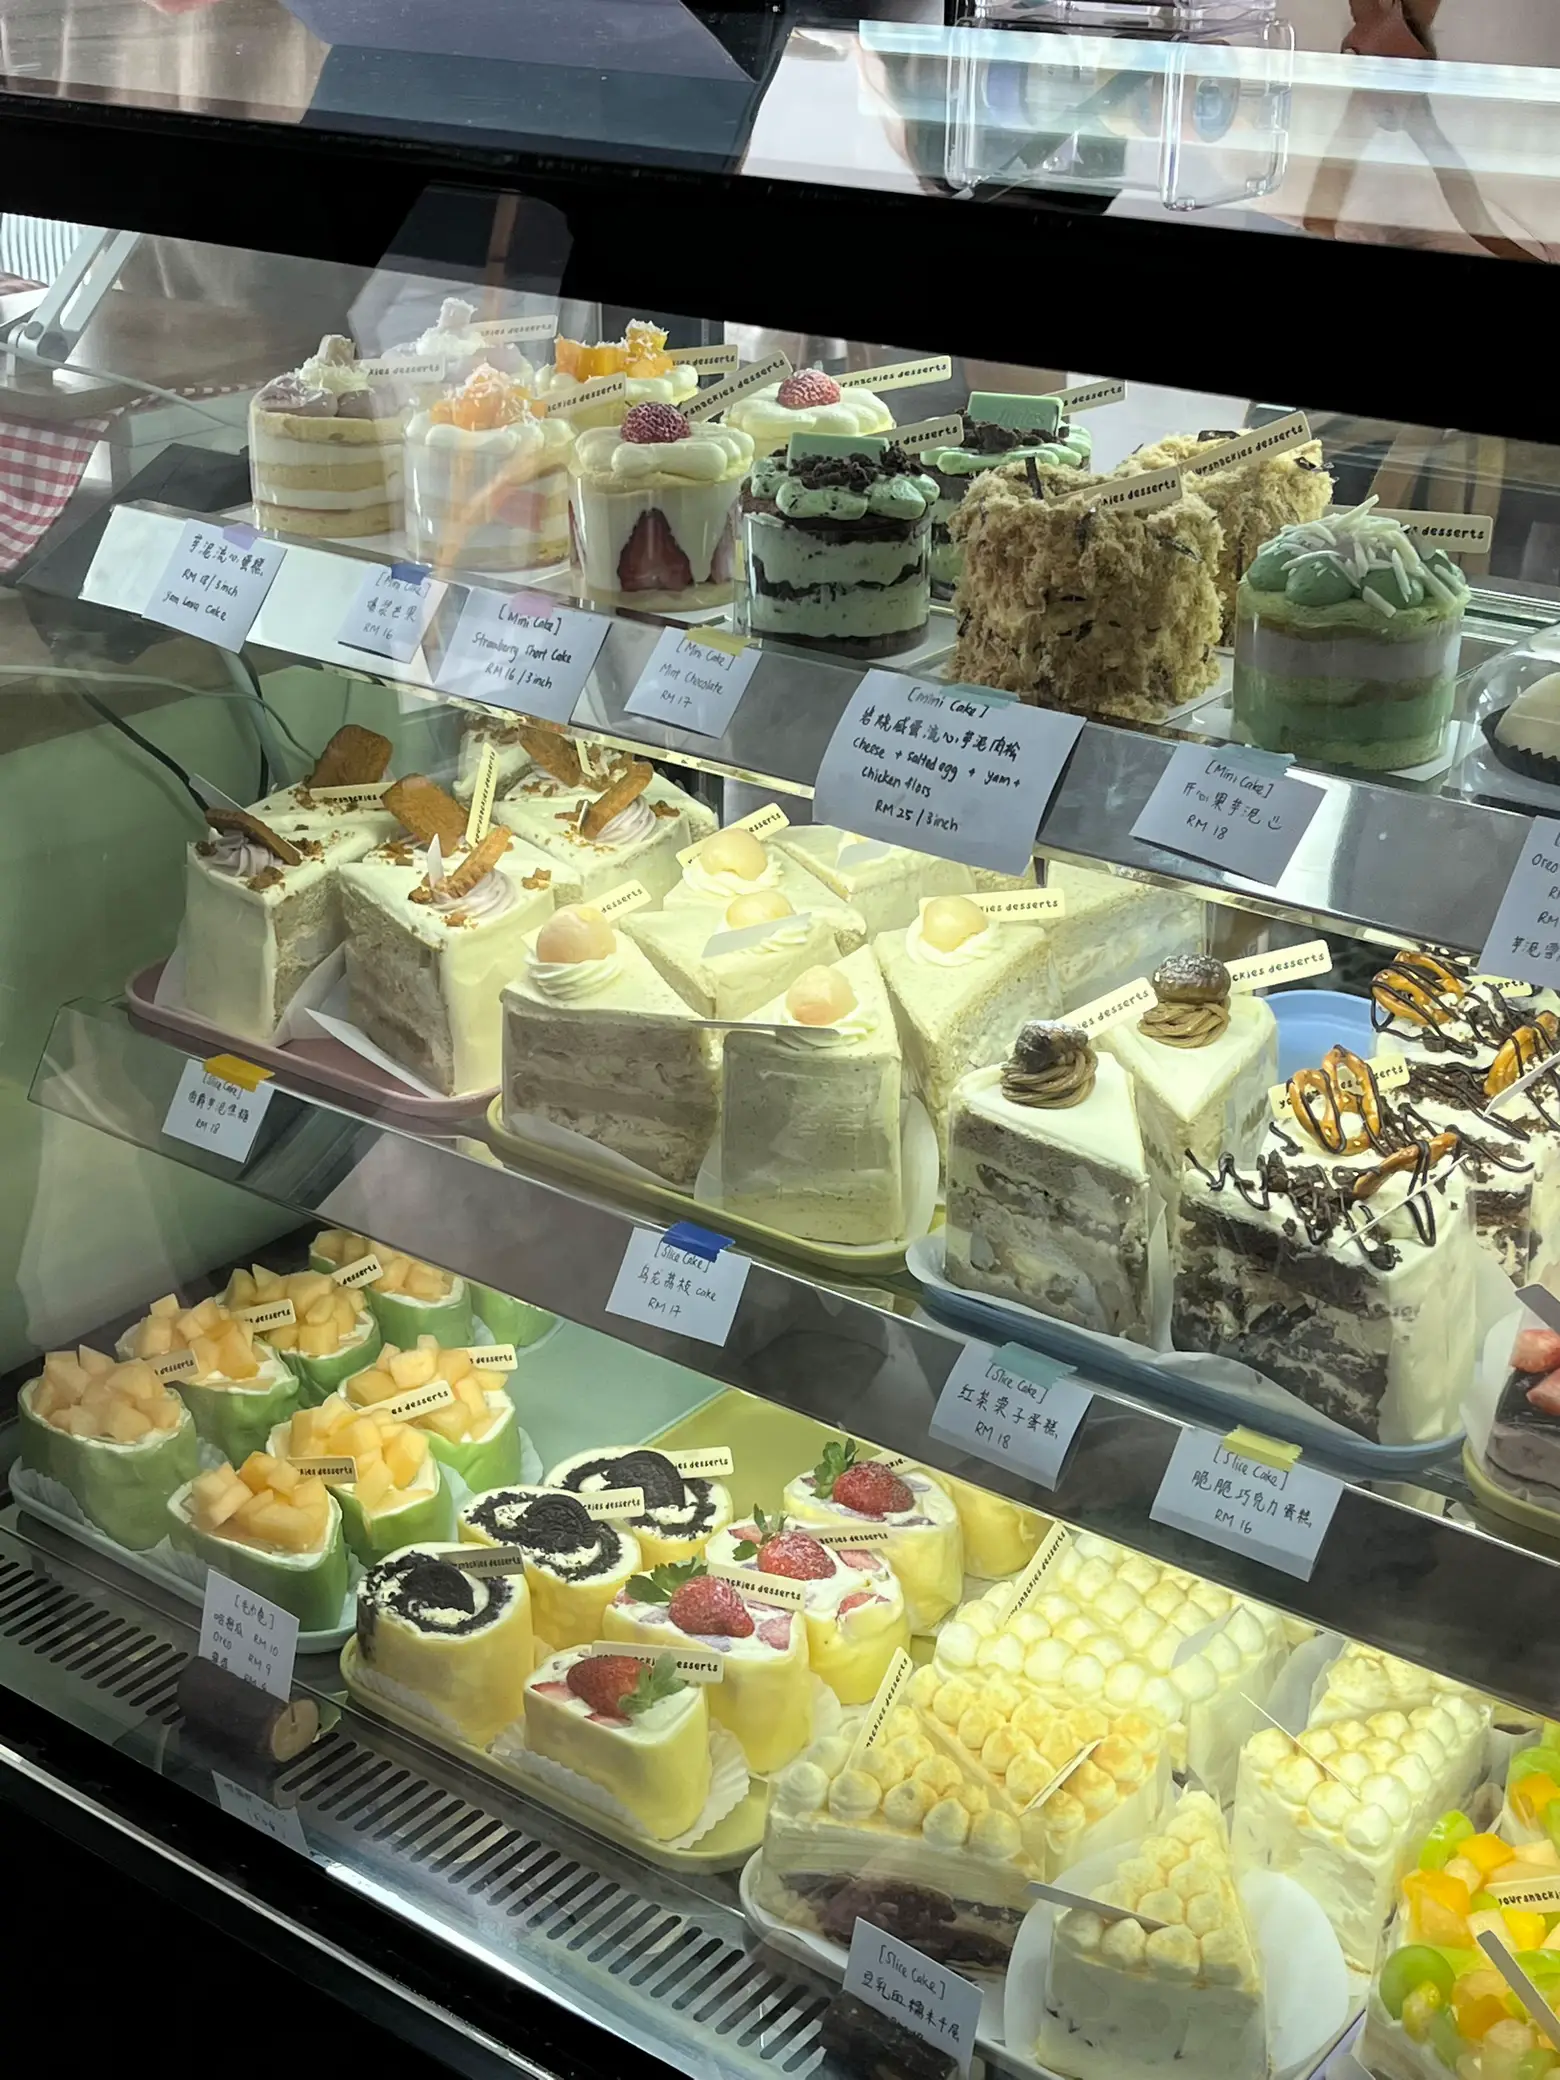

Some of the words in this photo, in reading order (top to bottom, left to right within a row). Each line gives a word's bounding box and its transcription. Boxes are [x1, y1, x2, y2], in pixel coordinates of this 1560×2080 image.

[692, 355, 736, 367] desserts
[897, 362, 947, 379] desserts
[737, 358, 785, 390] desserts
[578, 382, 623, 403] desserts
[1071, 385, 1123, 406] desserts
[903, 424, 958, 446] desserts
[1255, 424, 1304, 451] desserts
[1126, 479, 1177, 501] desserts
[1421, 525, 1485, 541] desserts
[363, 620, 382, 639] RM
[658, 662, 682, 679] Mint
[683, 669, 725, 696] Chocolate
[659, 688, 677, 704] RM
[874, 799, 895, 818] RM
[747, 811, 781, 834] esserts
[1186, 814, 1209, 833] RM
[1212, 825, 1229, 841] 18
[1531, 853, 1560, 874] Oreo
[601, 887, 643, 914] desserts
[1006, 899, 1059, 912] desserts
[1268, 953, 1326, 974] desserts
[1097, 988, 1150, 1022] desserts
[341, 1263, 378, 1286] desserts
[254, 1307, 292, 1323] desserts
[647, 1296, 667, 1314] RM
[475, 1353, 513, 1365] desserts
[404, 1390, 449, 1411] desserts
[957, 1383, 1059, 1440] 红茶栗子蛋糕
[974, 1420, 994, 1443] RM
[996, 1434, 1012, 1450] 18
[319, 1466, 353, 1477] desserts
[689, 1458, 729, 1470] desserts
[605, 1498, 641, 1511] desserts
[1190, 1469, 1314, 1529] 脆脆巧克力蛋糕
[1214, 1507, 1236, 1528] RM
[1239, 1518, 1254, 1535] 16
[849, 1532, 889, 1544] desserts
[1041, 1531, 1066, 1571] desserts
[757, 1584, 802, 1601] desserts
[676, 1659, 719, 1674] esserts
[885, 1657, 908, 1707] desserts
